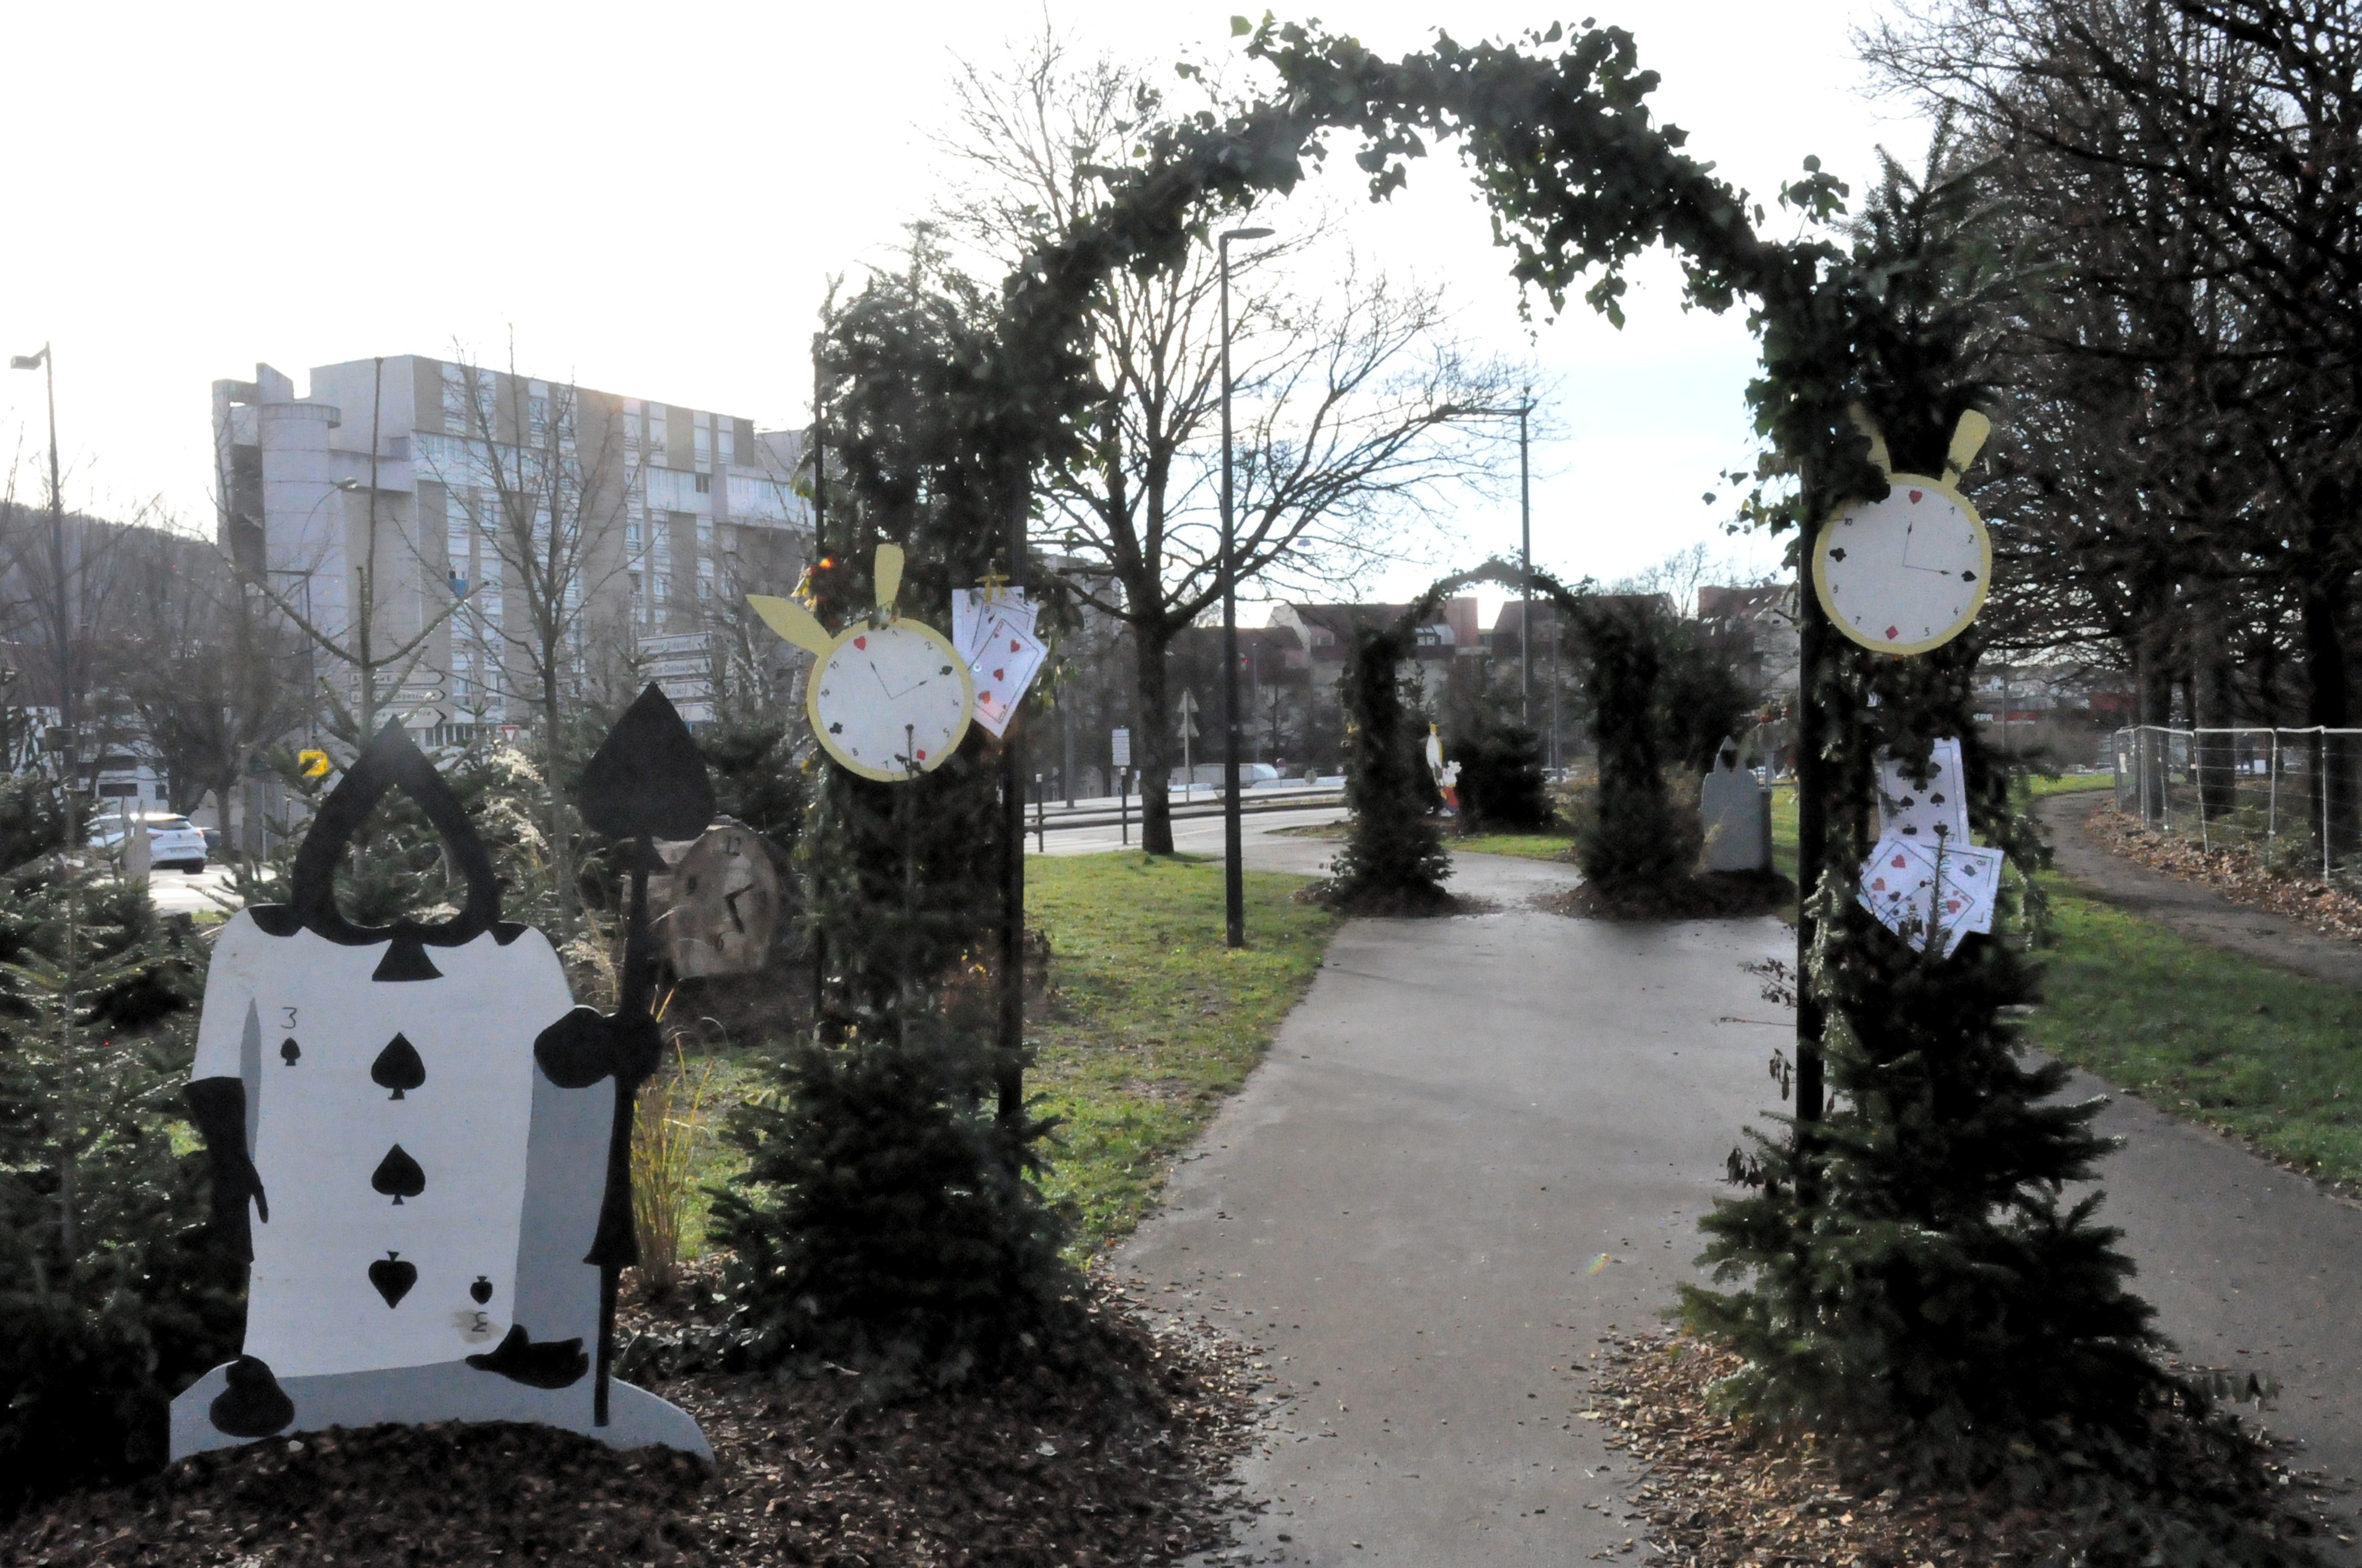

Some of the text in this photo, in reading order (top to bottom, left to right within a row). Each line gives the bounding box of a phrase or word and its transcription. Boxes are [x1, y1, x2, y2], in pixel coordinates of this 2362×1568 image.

[1968, 534, 1975, 544] 2
[1953, 606, 1959, 616] 4
[1924, 626, 1930, 636] 5
[924, 640, 933, 650] 2
[280, 1007, 297, 1029] 3
